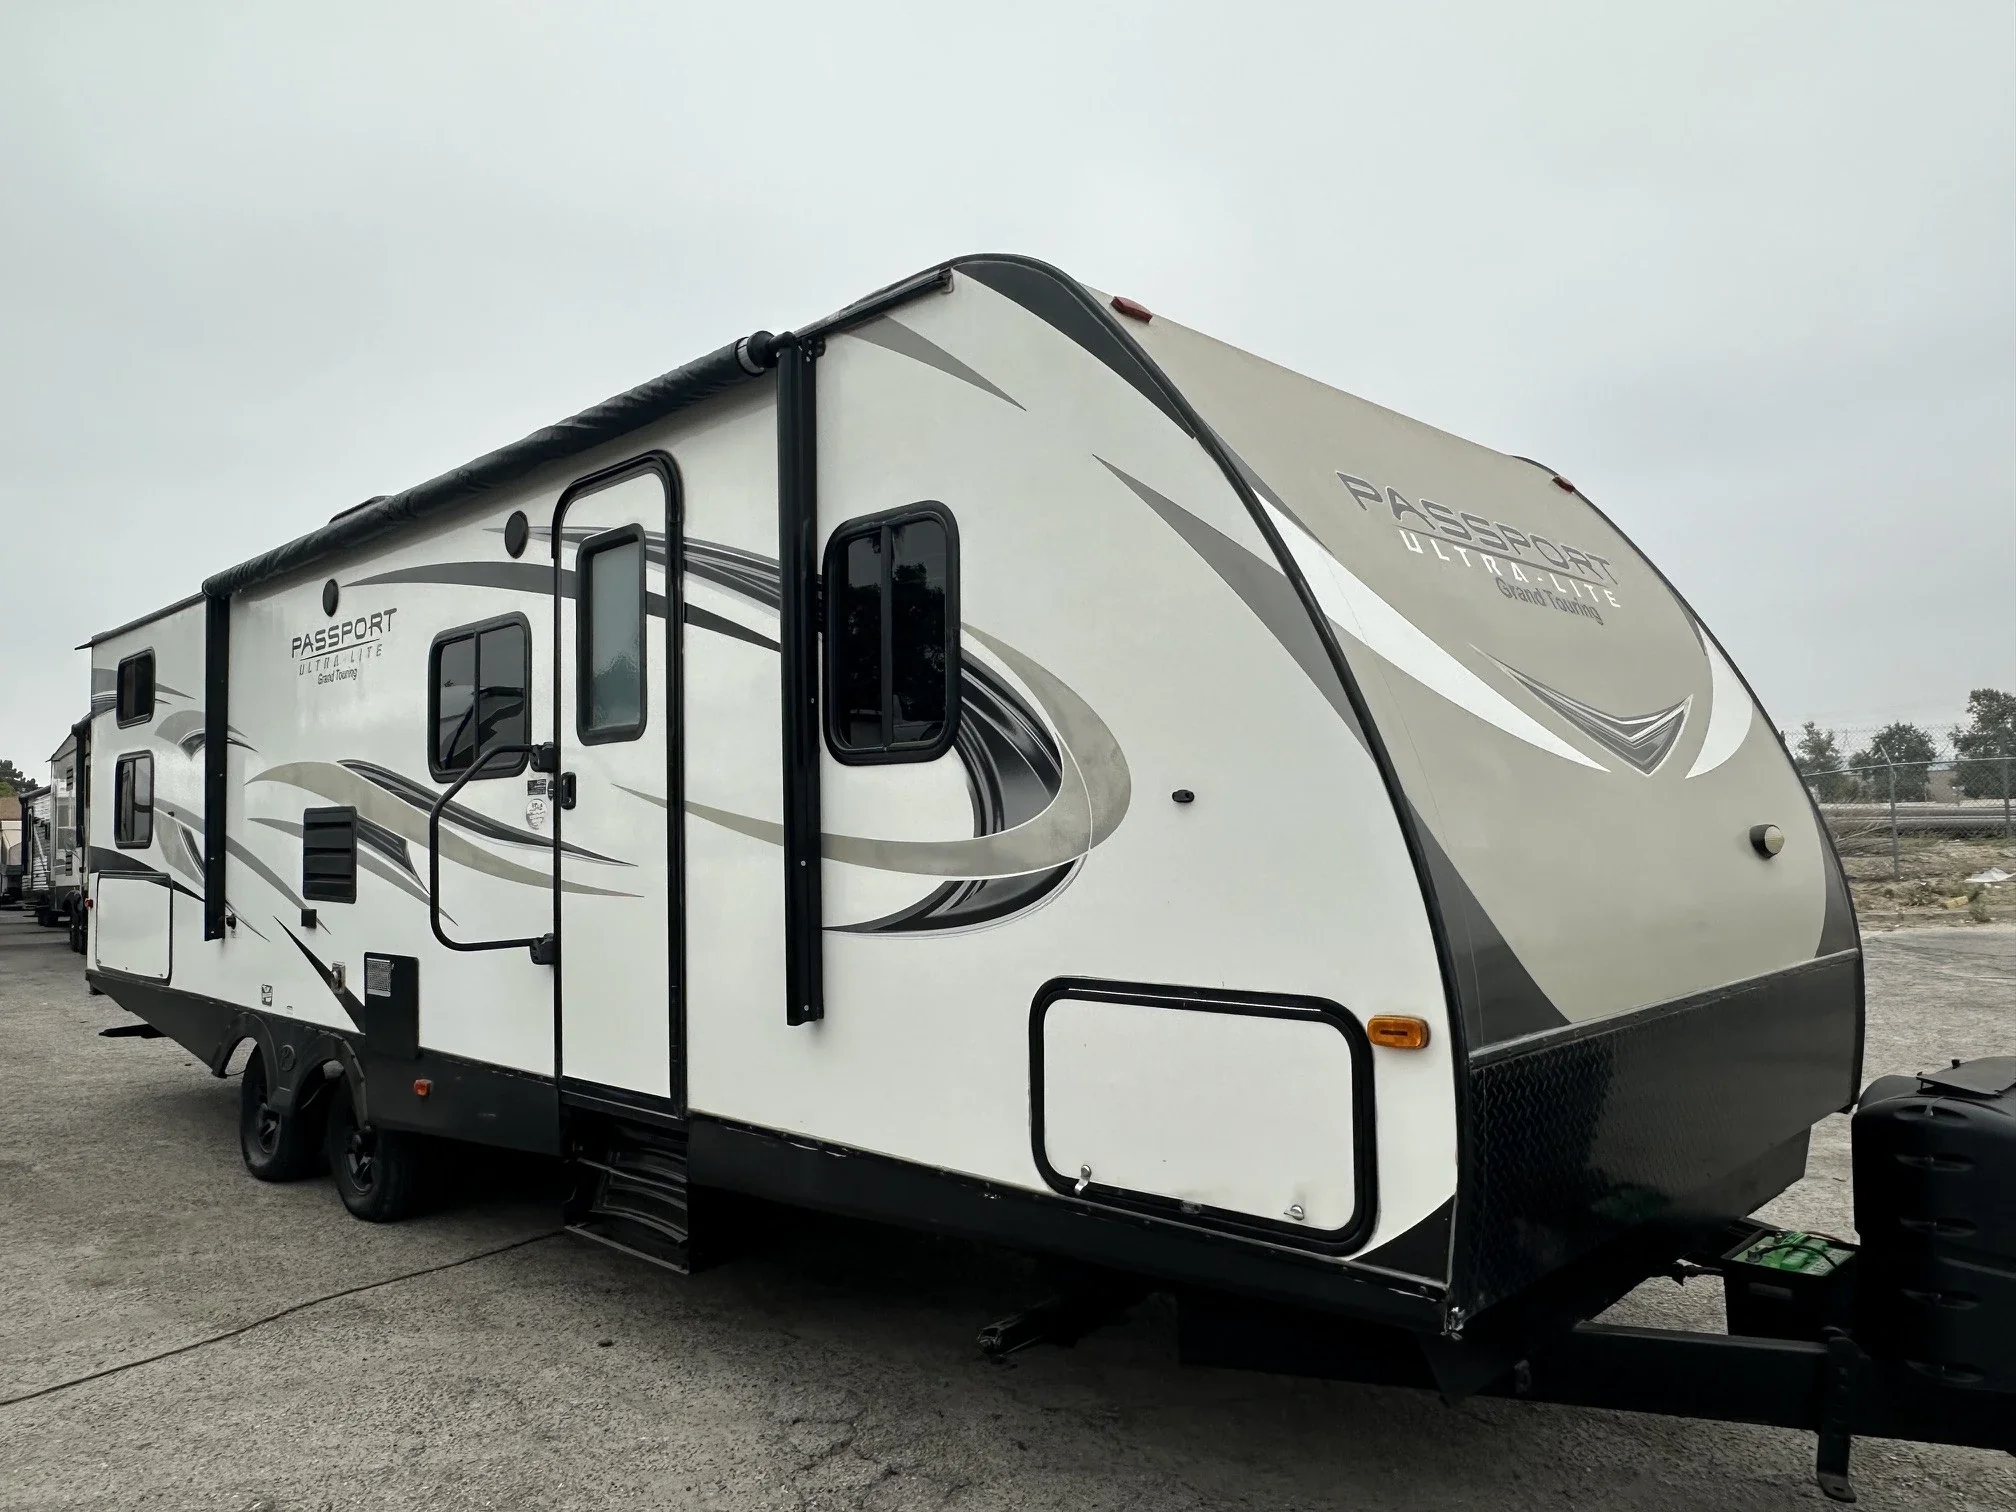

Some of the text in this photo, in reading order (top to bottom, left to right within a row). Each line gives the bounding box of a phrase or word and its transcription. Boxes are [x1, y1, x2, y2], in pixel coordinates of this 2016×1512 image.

[1336, 470, 1619, 585] PASSPORT
[1495, 576, 1604, 625] Grand Touring
[291, 607, 398, 658] PASSPORT
